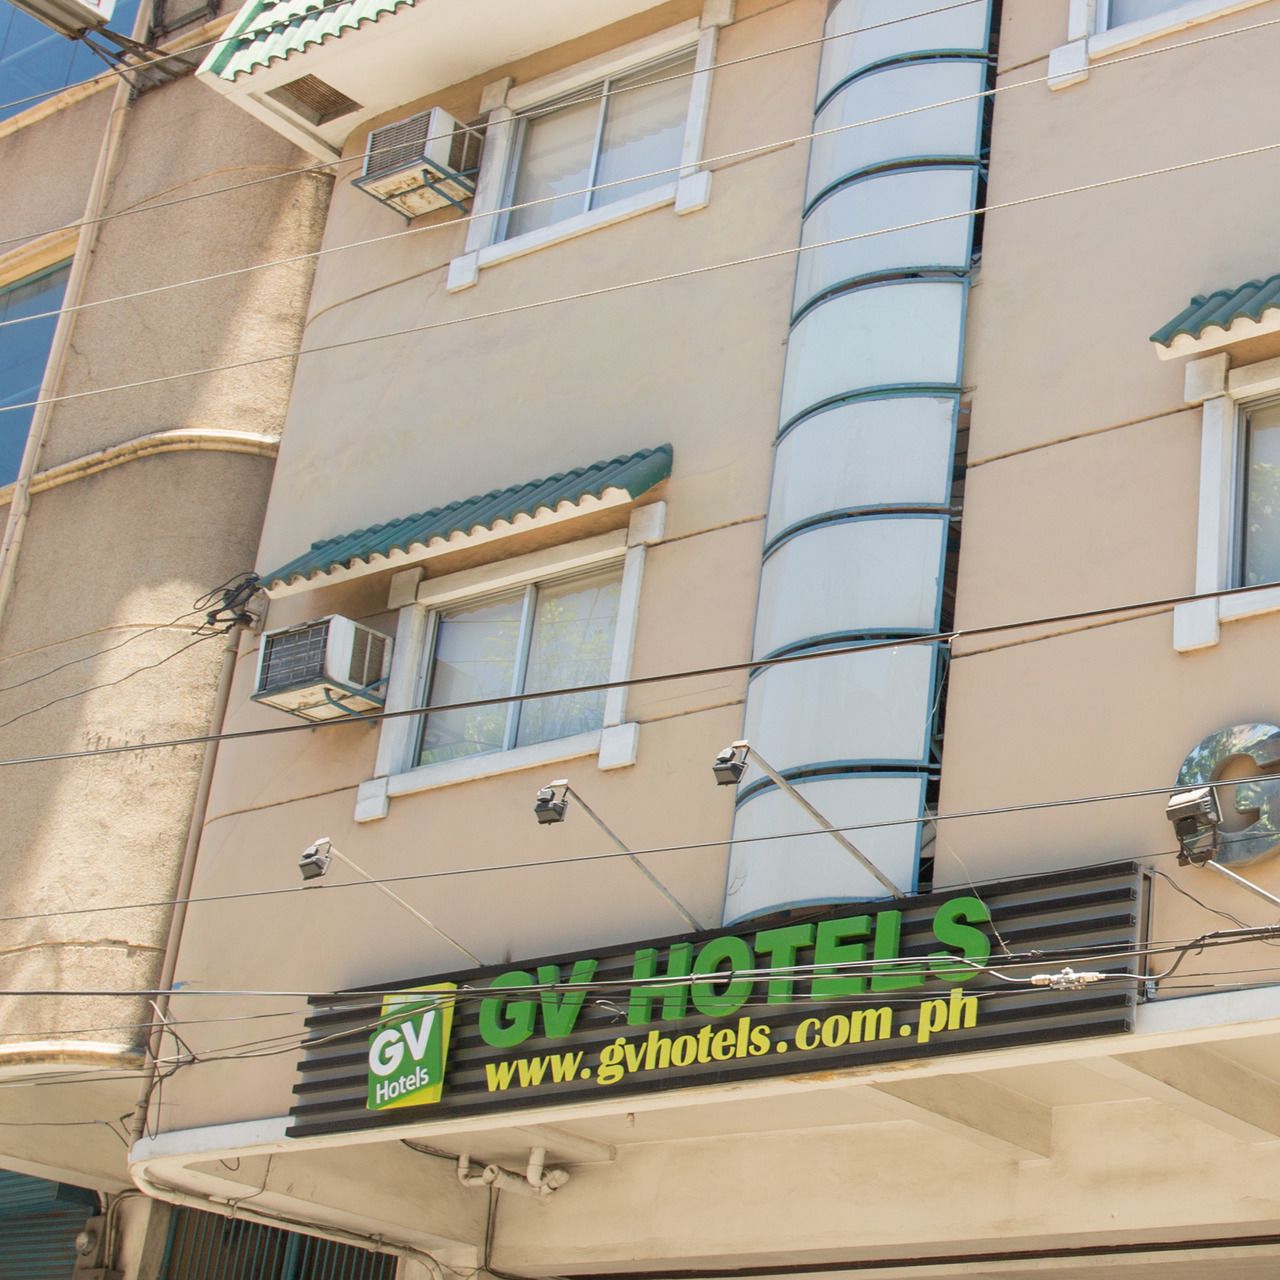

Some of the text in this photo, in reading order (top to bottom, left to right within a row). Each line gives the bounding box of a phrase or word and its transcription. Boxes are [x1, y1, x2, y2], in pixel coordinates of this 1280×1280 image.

[479, 896, 991, 1048] GV HOTELS
[369, 1010, 436, 1077] GV
[376, 1066, 430, 1104] Hotels
